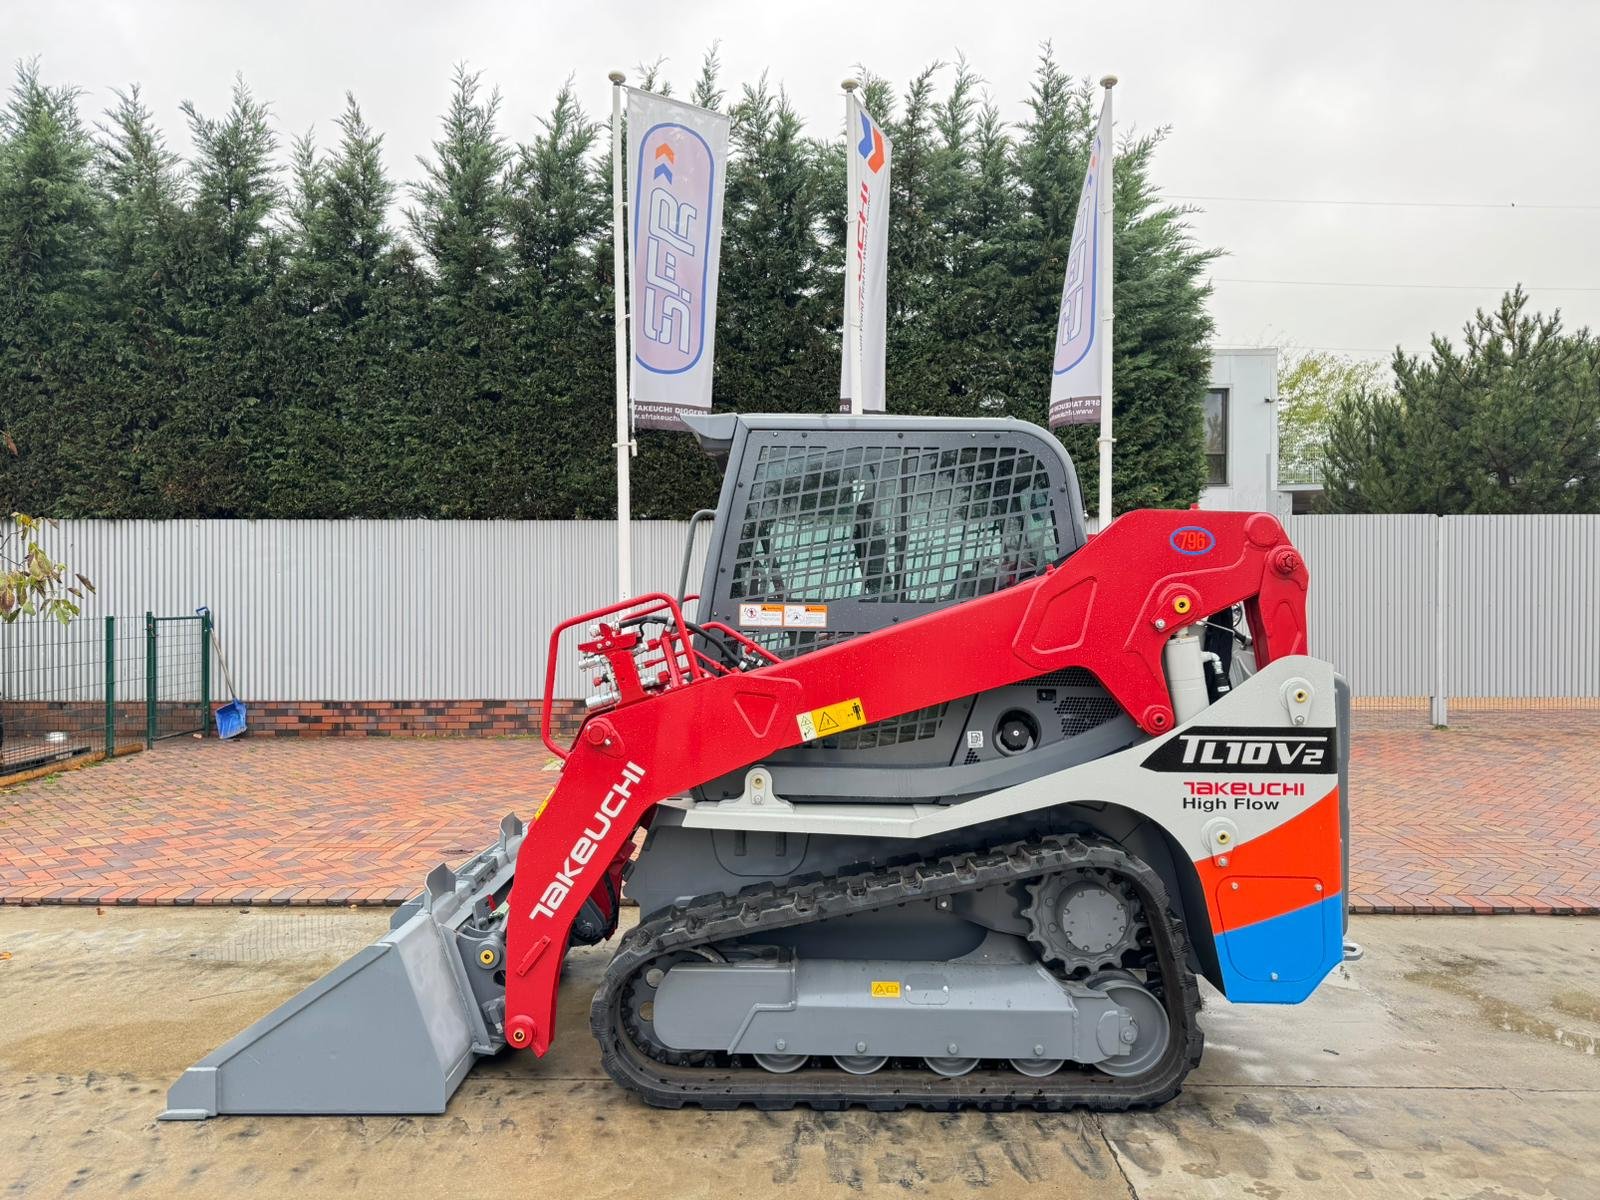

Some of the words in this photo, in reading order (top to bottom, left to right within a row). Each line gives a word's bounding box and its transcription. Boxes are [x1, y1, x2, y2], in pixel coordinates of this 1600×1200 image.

[643, 187, 697, 355] SFR
[634, 404, 673, 414] TAKEUCHI
[1179, 531, 1206, 550] 796
[1179, 735, 1328, 765] TL10V2
[1183, 782, 1305, 796] TAKEUCHI
[1183, 798, 1227, 812] High
[1234, 798, 1279, 810] Flow
[529, 761, 646, 920] TAKEUCHI
